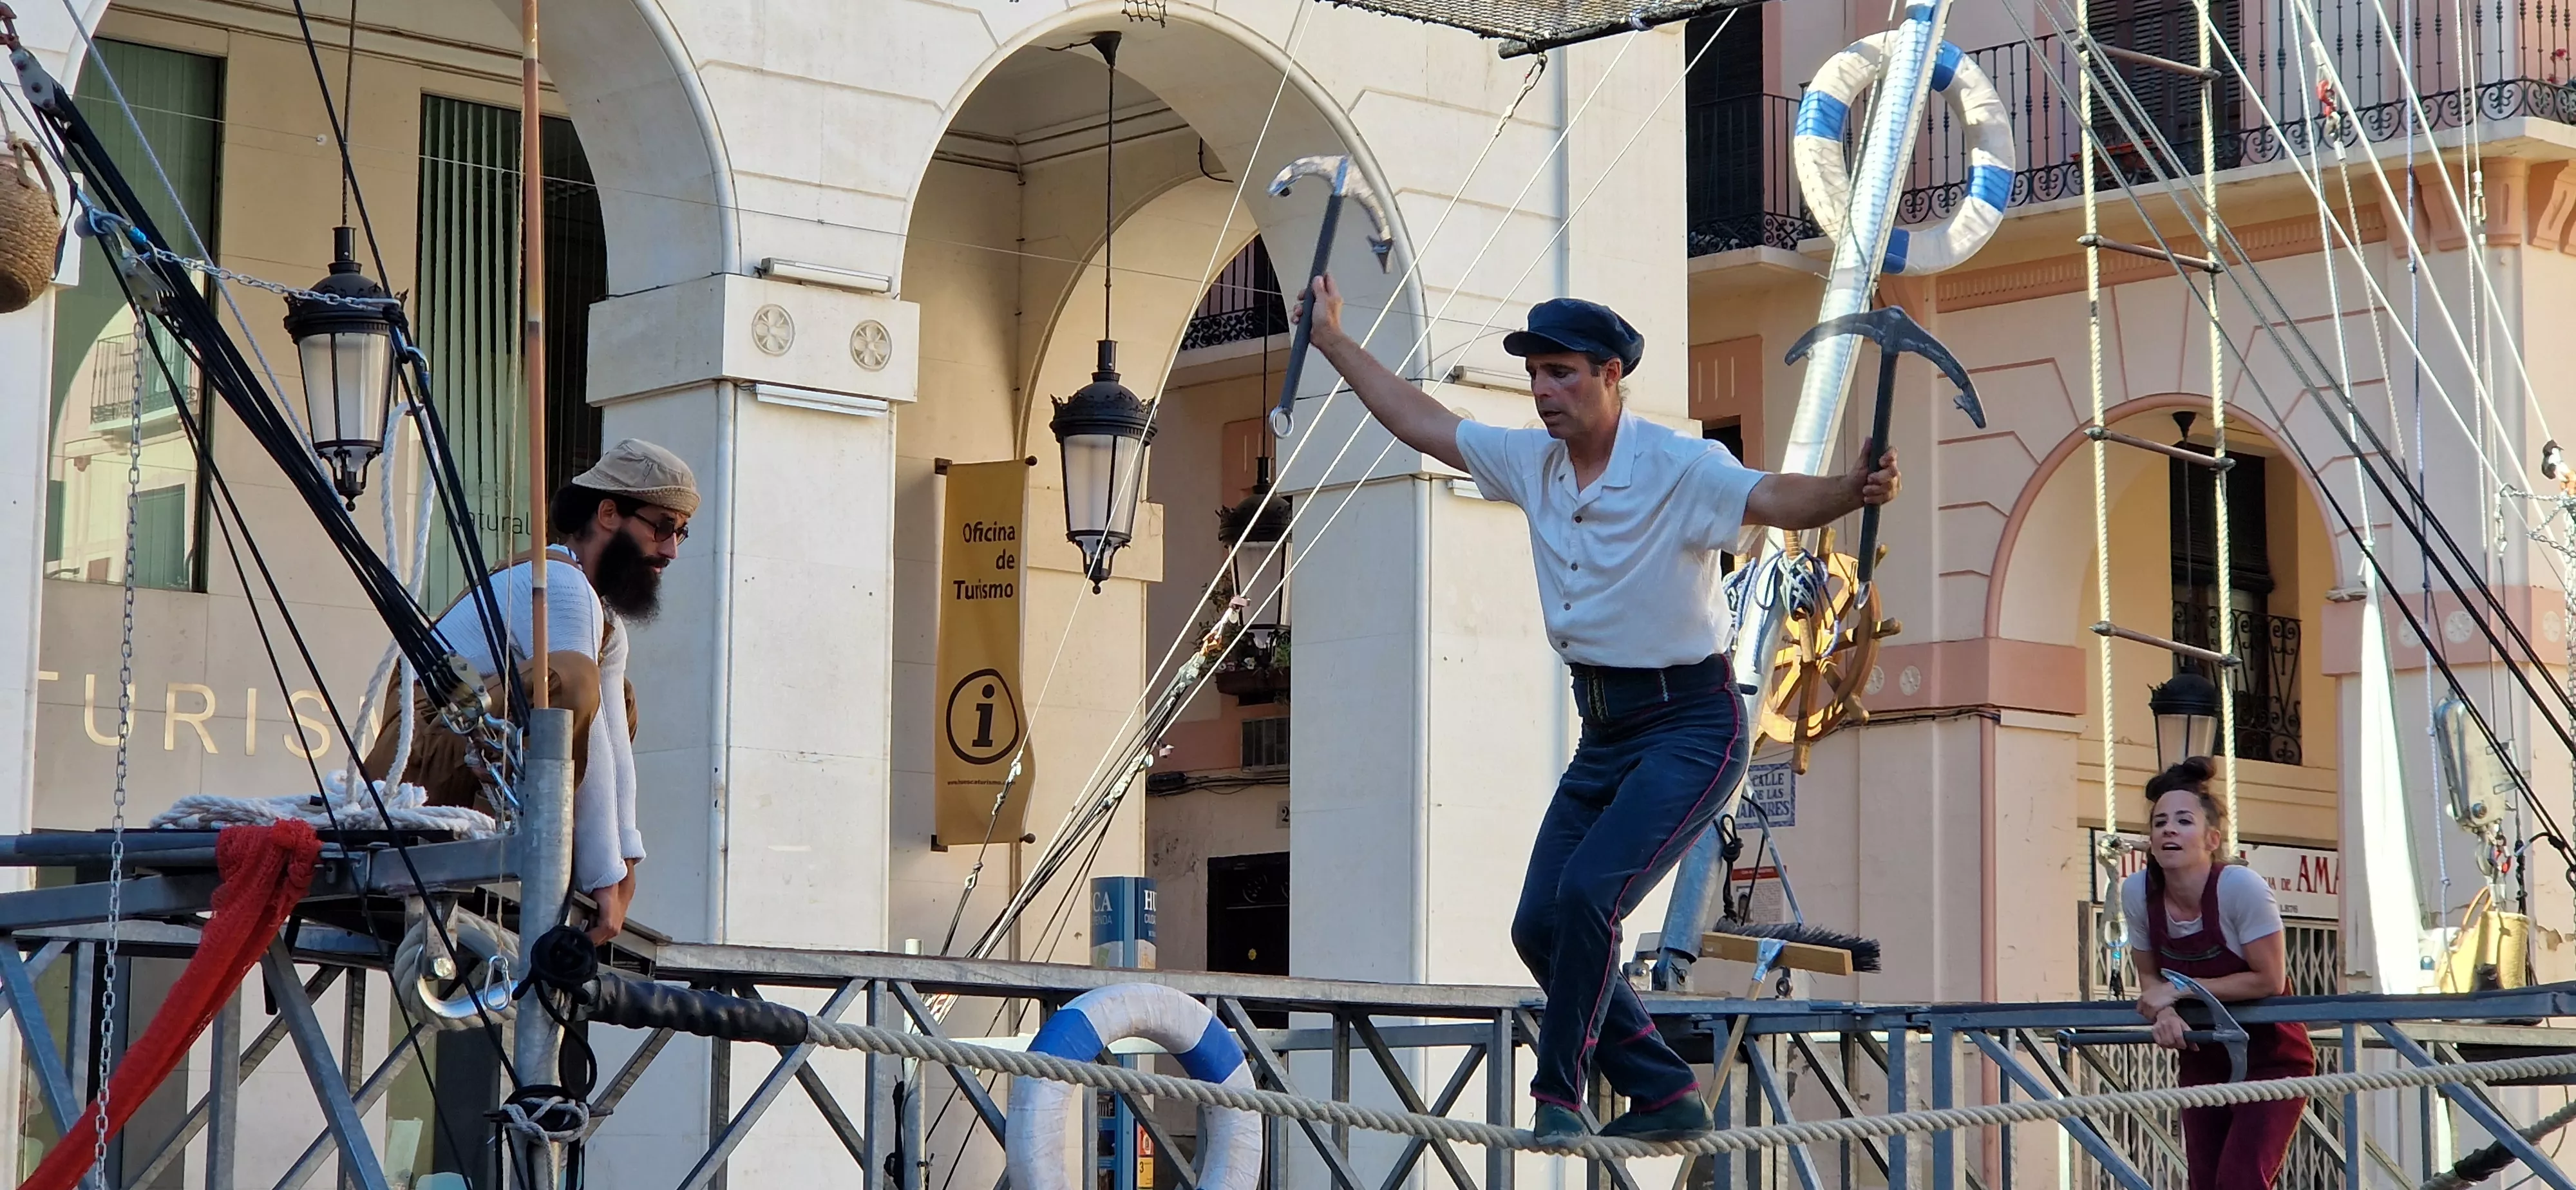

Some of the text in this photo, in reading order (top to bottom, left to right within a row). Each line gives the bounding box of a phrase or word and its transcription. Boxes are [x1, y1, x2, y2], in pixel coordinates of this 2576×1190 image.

[445, 511, 531, 536] atural
[963, 520, 1016, 543] Oficina
[996, 548, 1015, 570] de
[952, 578, 1014, 600] Turismo
[39, 671, 388, 760] URIS
[1752, 773, 1785, 787] CALLE
[1766, 788, 1784, 799] LAS
[1090, 891, 1113, 912] CA
